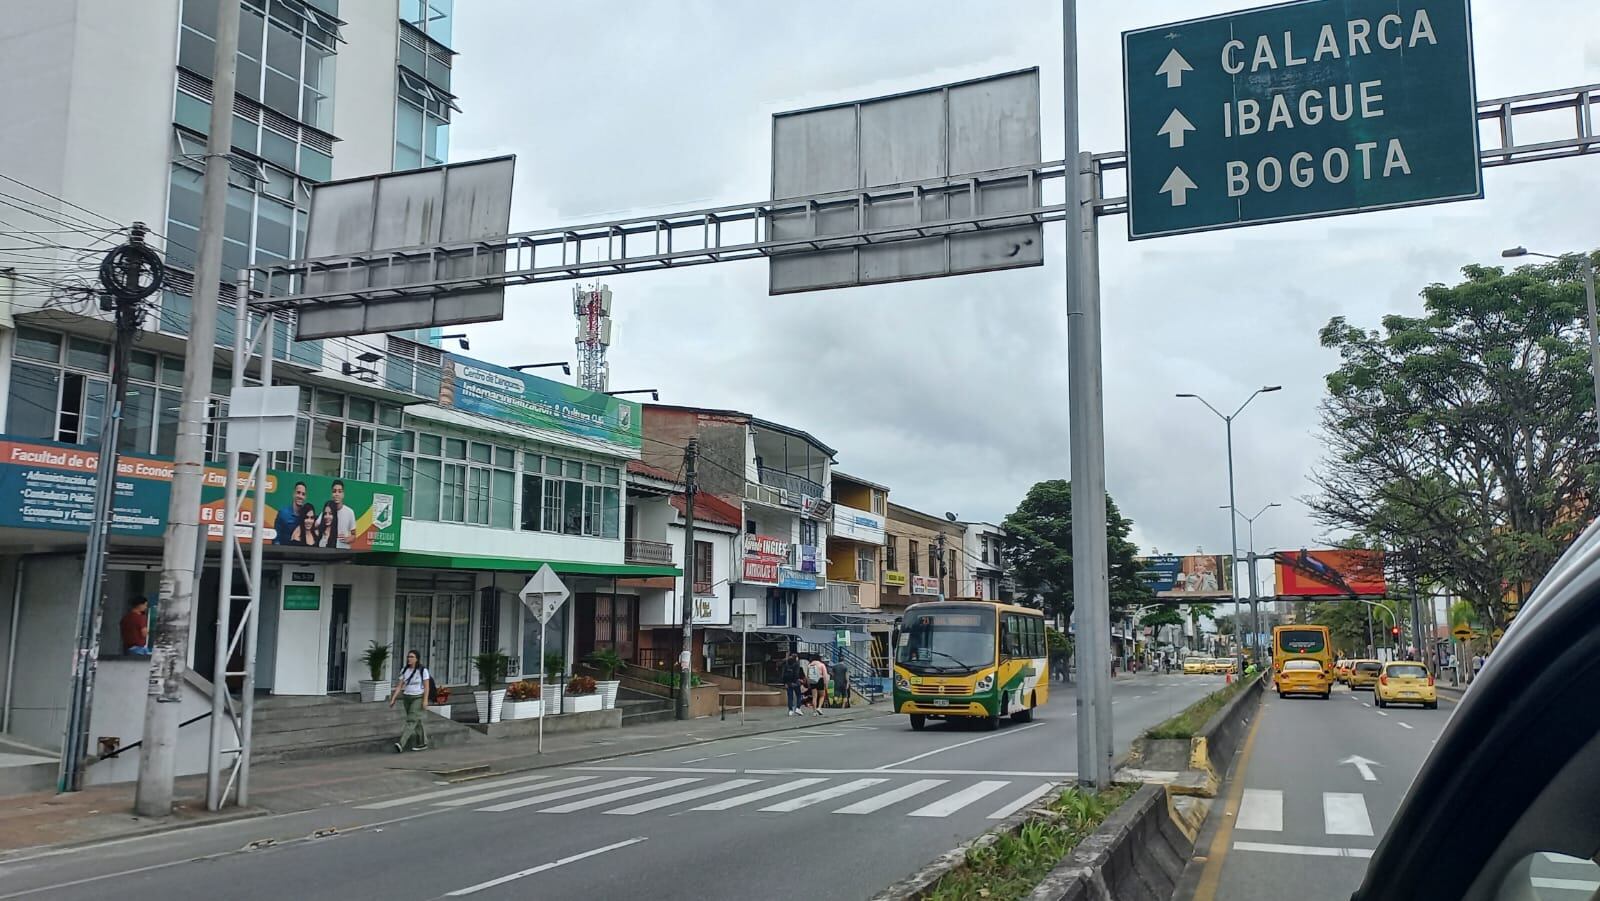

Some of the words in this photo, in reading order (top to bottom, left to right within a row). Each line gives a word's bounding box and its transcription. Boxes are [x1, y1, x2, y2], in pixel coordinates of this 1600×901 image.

[1221, 9, 1438, 75] CALARCA
[1224, 79, 1384, 138] IBAGUE
[1226, 138, 1412, 197] BOGOTA
[11, 447, 66, 465] Facultad
[68, 455, 83, 468] de
[26, 471, 87, 485] Administración
[762, 540, 787, 556] INGLES
